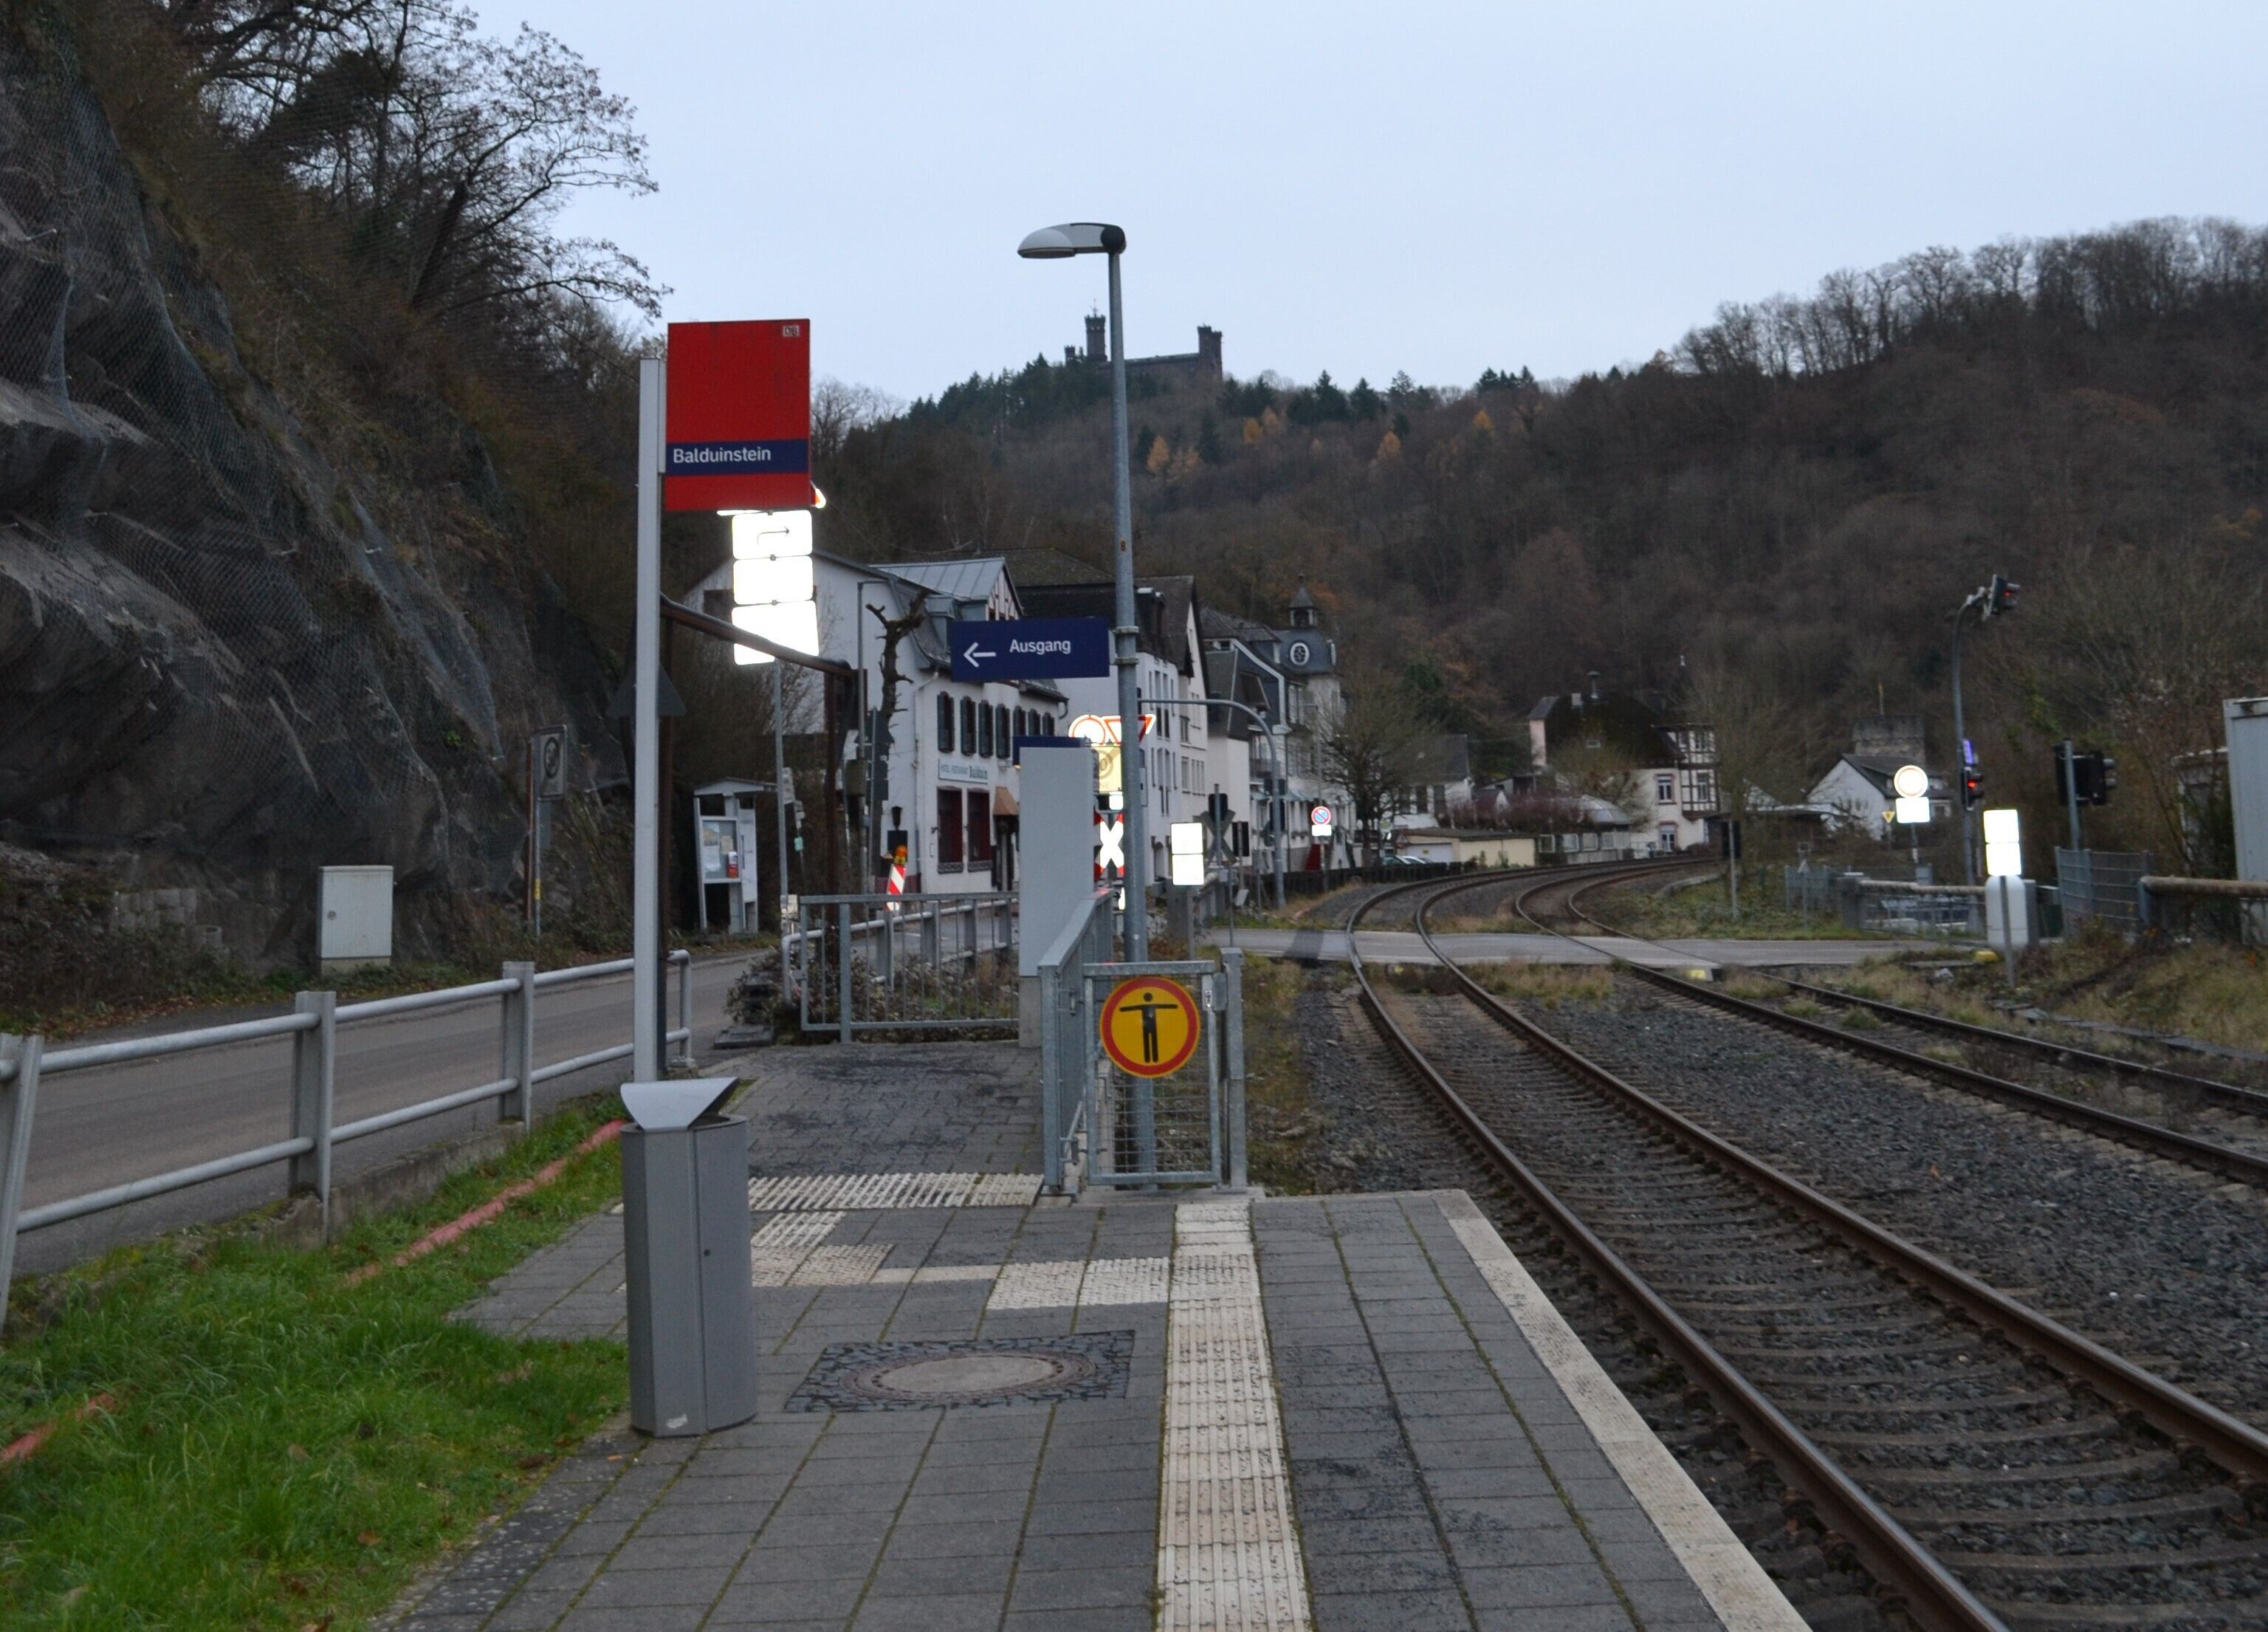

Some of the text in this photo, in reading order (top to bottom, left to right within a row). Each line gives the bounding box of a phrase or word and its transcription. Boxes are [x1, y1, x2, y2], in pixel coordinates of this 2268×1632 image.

[784, 326, 798, 337] DB
[673, 447, 771, 464] Balduinstein
[1009, 639, 1071, 655] Ausgang
